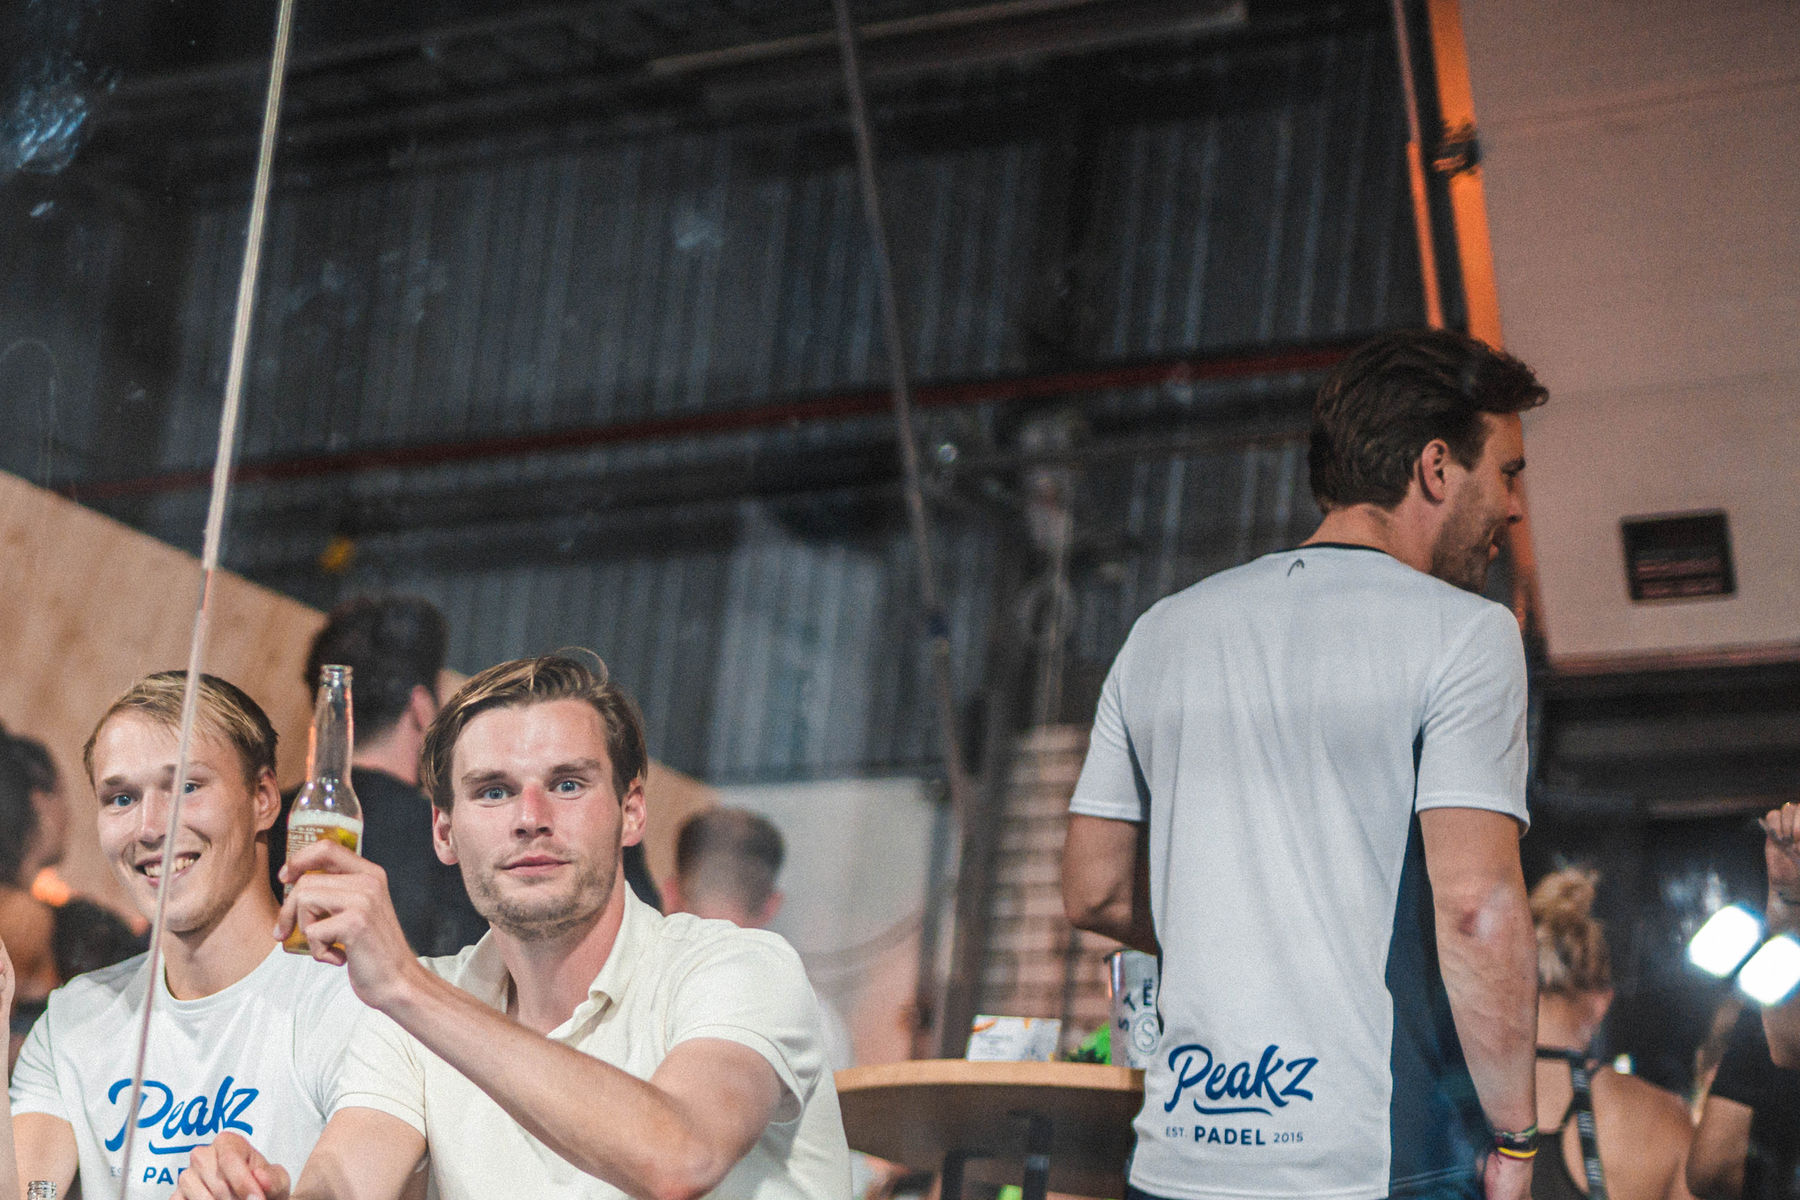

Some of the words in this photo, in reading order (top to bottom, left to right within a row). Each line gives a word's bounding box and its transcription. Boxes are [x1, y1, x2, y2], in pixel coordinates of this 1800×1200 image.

[1164, 1043, 1319, 1113] Peakz
[104, 1075, 259, 1152] Peakz
[1194, 1125, 1266, 1146] PADEL
[1273, 1131, 1304, 1144] 2015
